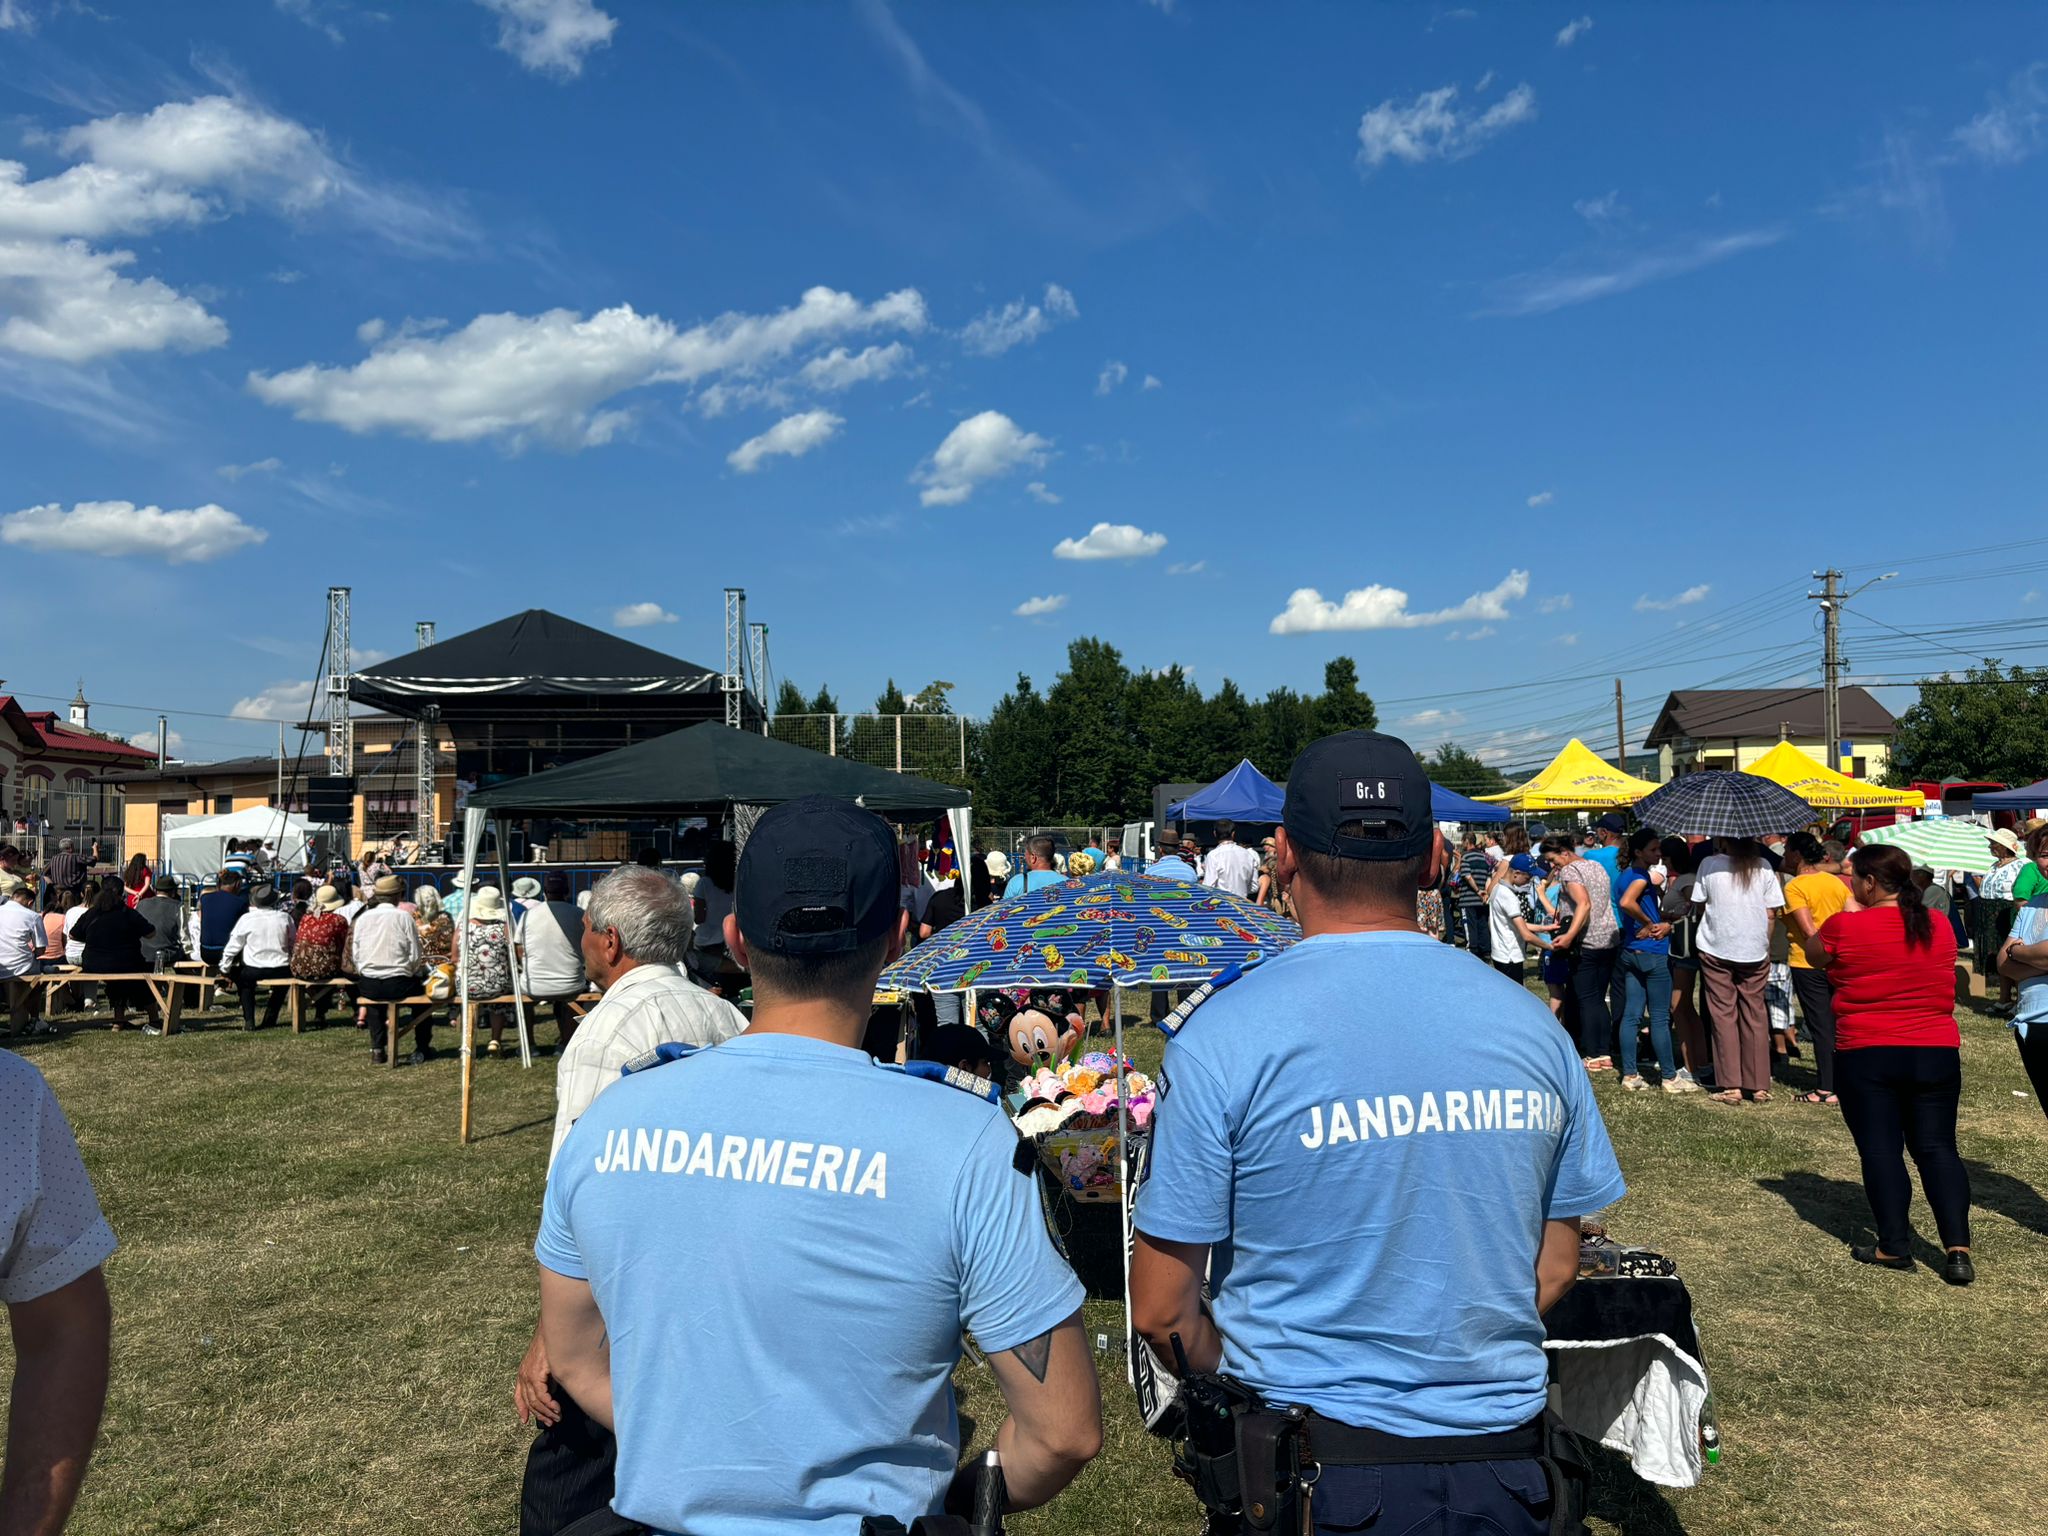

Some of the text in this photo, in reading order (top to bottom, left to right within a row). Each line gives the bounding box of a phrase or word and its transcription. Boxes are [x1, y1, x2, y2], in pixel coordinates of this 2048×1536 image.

[1356, 782, 1385, 799] Gr. 6
[1546, 797, 1579, 805] REGINA
[1844, 796, 1851, 805] A
[1852, 794, 1904, 805] BUCOVINEI
[1300, 1089, 1562, 1149] JANDARMERIA
[594, 1128, 887, 1199] JANDARMERIA
